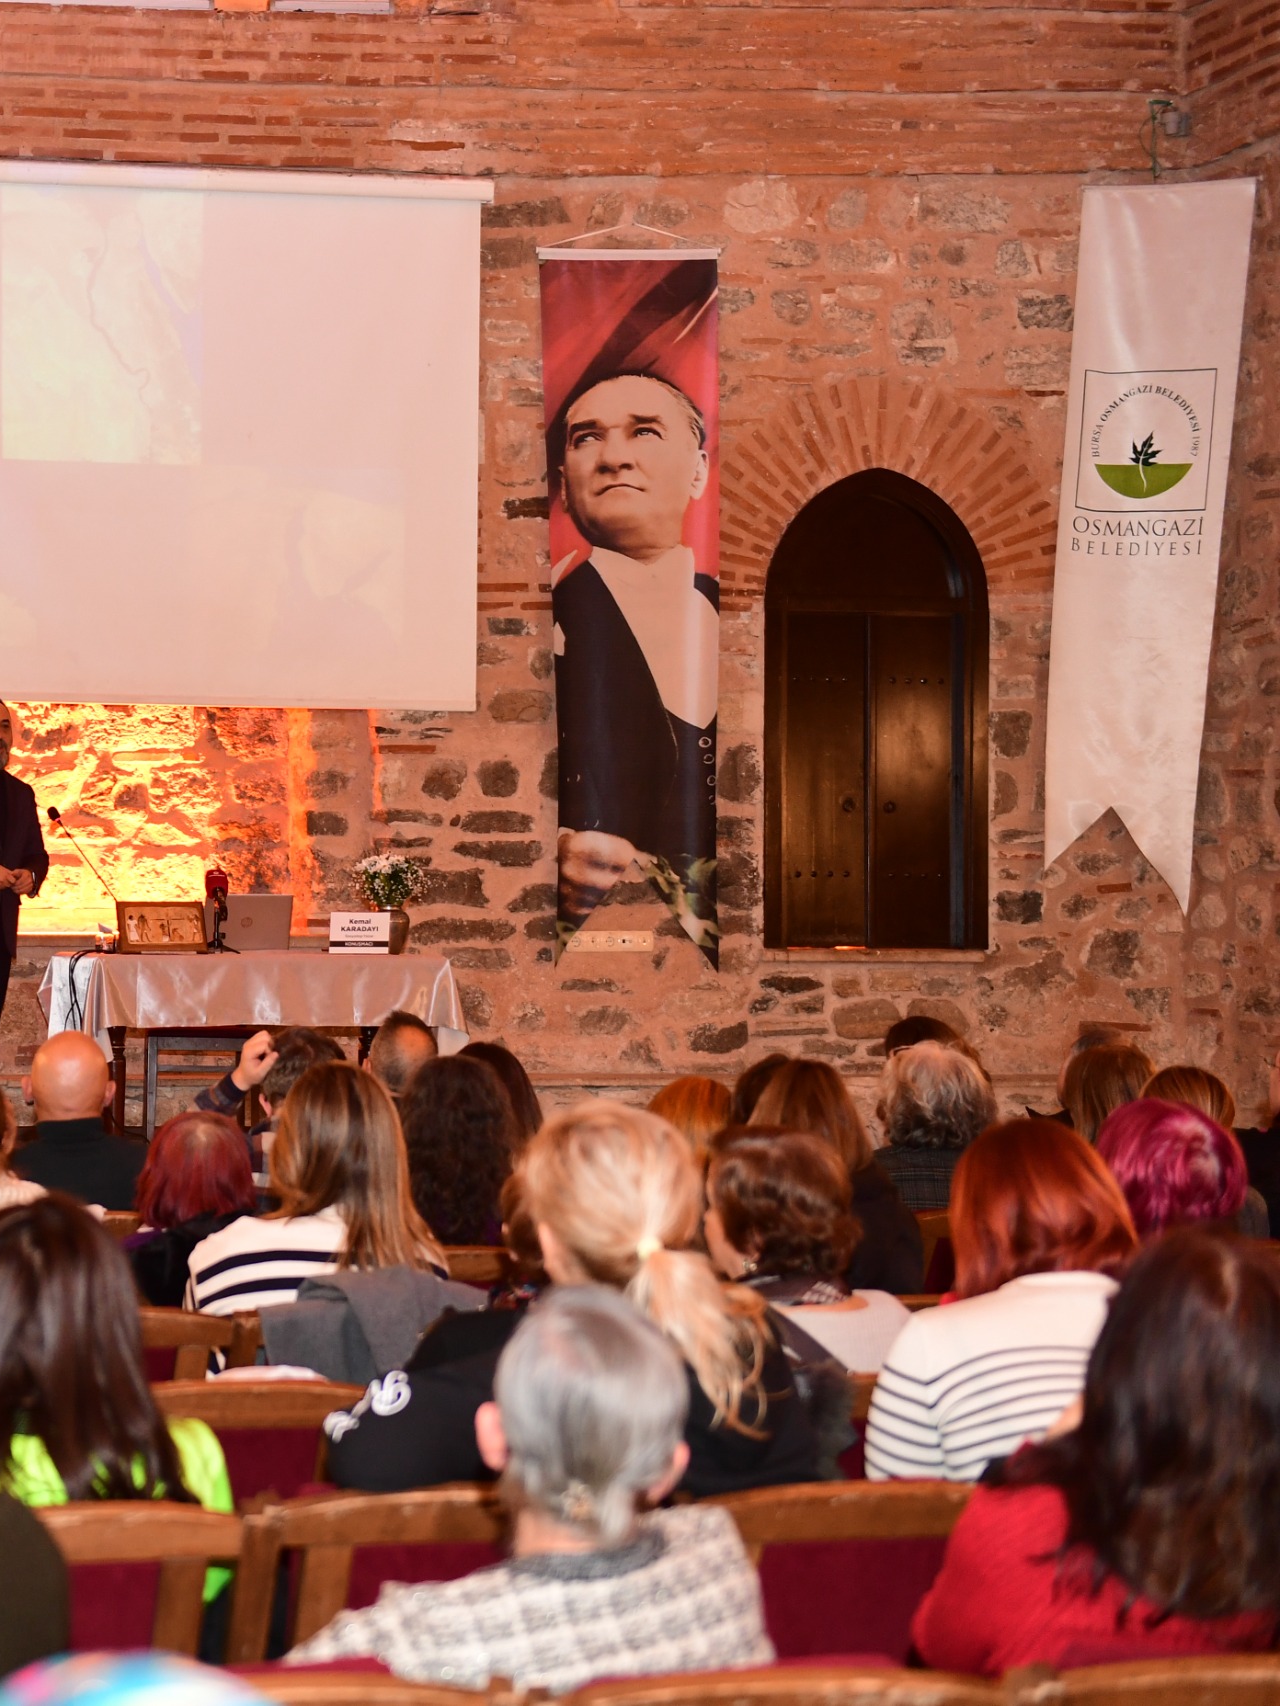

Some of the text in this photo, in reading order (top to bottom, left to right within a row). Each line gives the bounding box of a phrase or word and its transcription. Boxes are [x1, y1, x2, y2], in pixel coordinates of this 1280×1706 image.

[1091, 383, 1201, 458] BURSA OSMANGAZİ BELEDİYESİ 1987
[1072, 516, 1203, 537] OSMANGAZİ
[1071, 537, 1202, 556] BELEDİYESİ
